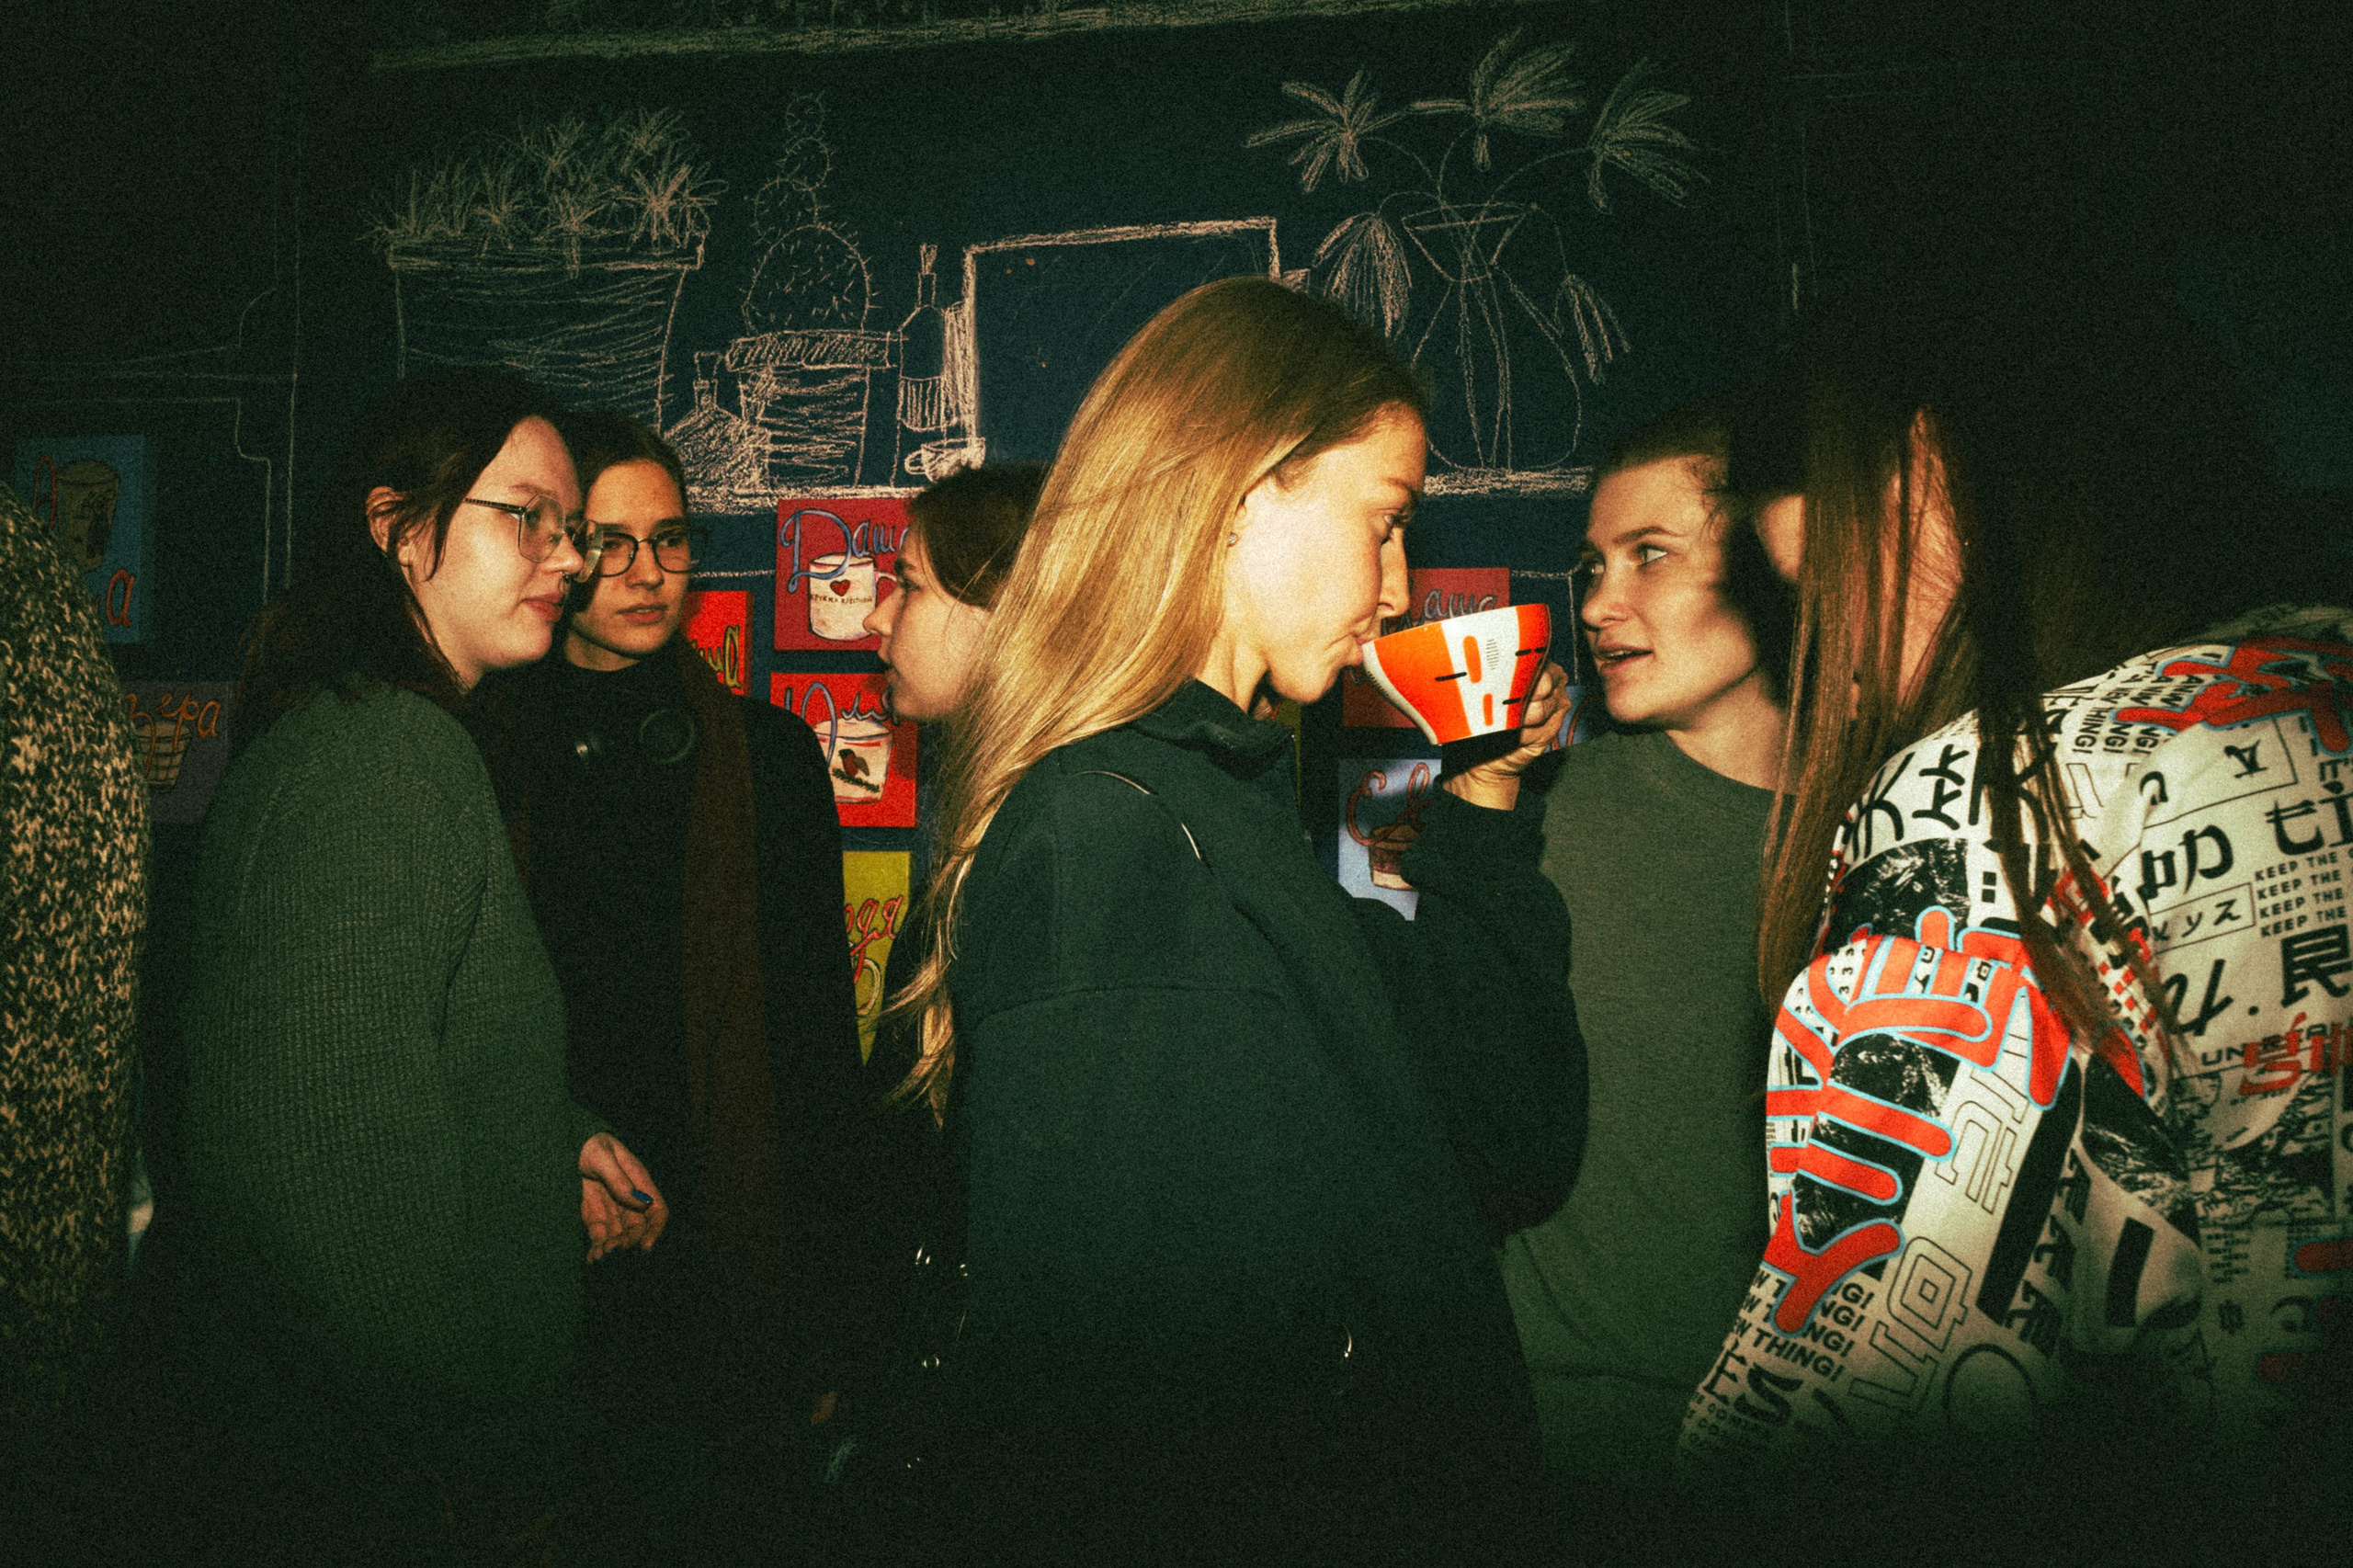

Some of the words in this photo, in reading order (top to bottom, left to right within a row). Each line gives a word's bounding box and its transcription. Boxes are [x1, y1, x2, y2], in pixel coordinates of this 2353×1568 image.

[2254, 860, 2299, 881] KEEP
[2306, 851, 2338, 869] THE
[2256, 879, 2302, 901] KEEP
[2311, 869, 2341, 886] THE
[2259, 896, 2305, 919] KEEP
[2313, 888, 2344, 904] THE
[2260, 915, 2308, 937] KEEP
[2316, 905, 2347, 924] THE
[1753, 1328, 1845, 1382] THING!
